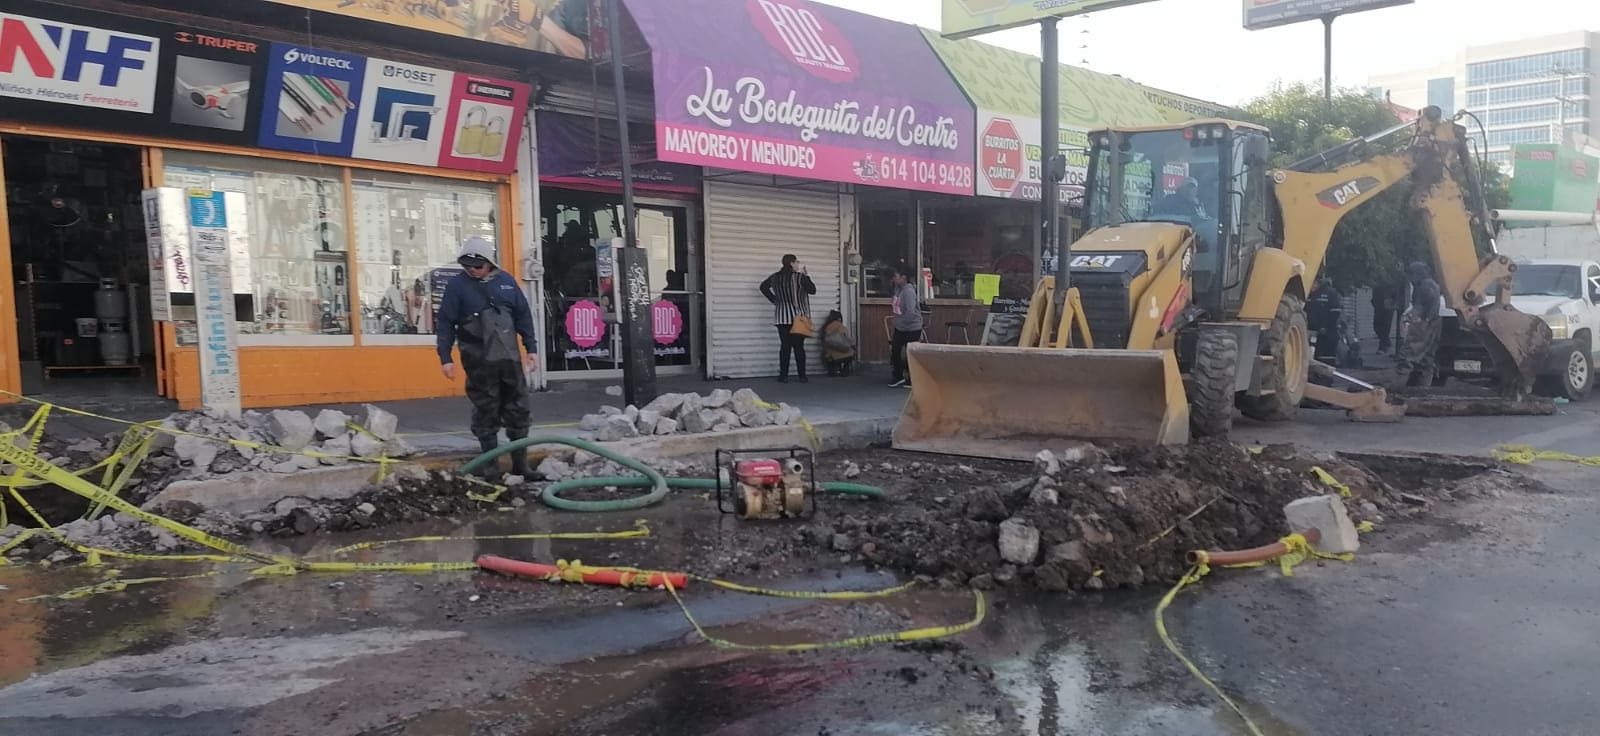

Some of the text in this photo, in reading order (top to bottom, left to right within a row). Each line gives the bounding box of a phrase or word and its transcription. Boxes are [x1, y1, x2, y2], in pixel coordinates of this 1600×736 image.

[196, 34, 258, 53] TRUPER
[758, 0, 846, 66] BDC
[0, 18, 153, 87] NHF
[395, 67, 437, 84] FOSET
[686, 66, 959, 150] La Bodeguita del Centro
[665, 127, 816, 170] MAYOREO Y MENUDEO
[984, 135, 1019, 151] BURRITOS
[997, 152, 1007, 164] LA
[880, 156, 972, 188] 614 104 9428
[988, 166, 1016, 180] CUARTA
[1333, 180, 1360, 205] CAT
[1069, 255, 1122, 268] CAT
[574, 308, 598, 337] BDC
[654, 307, 676, 335] BDC
